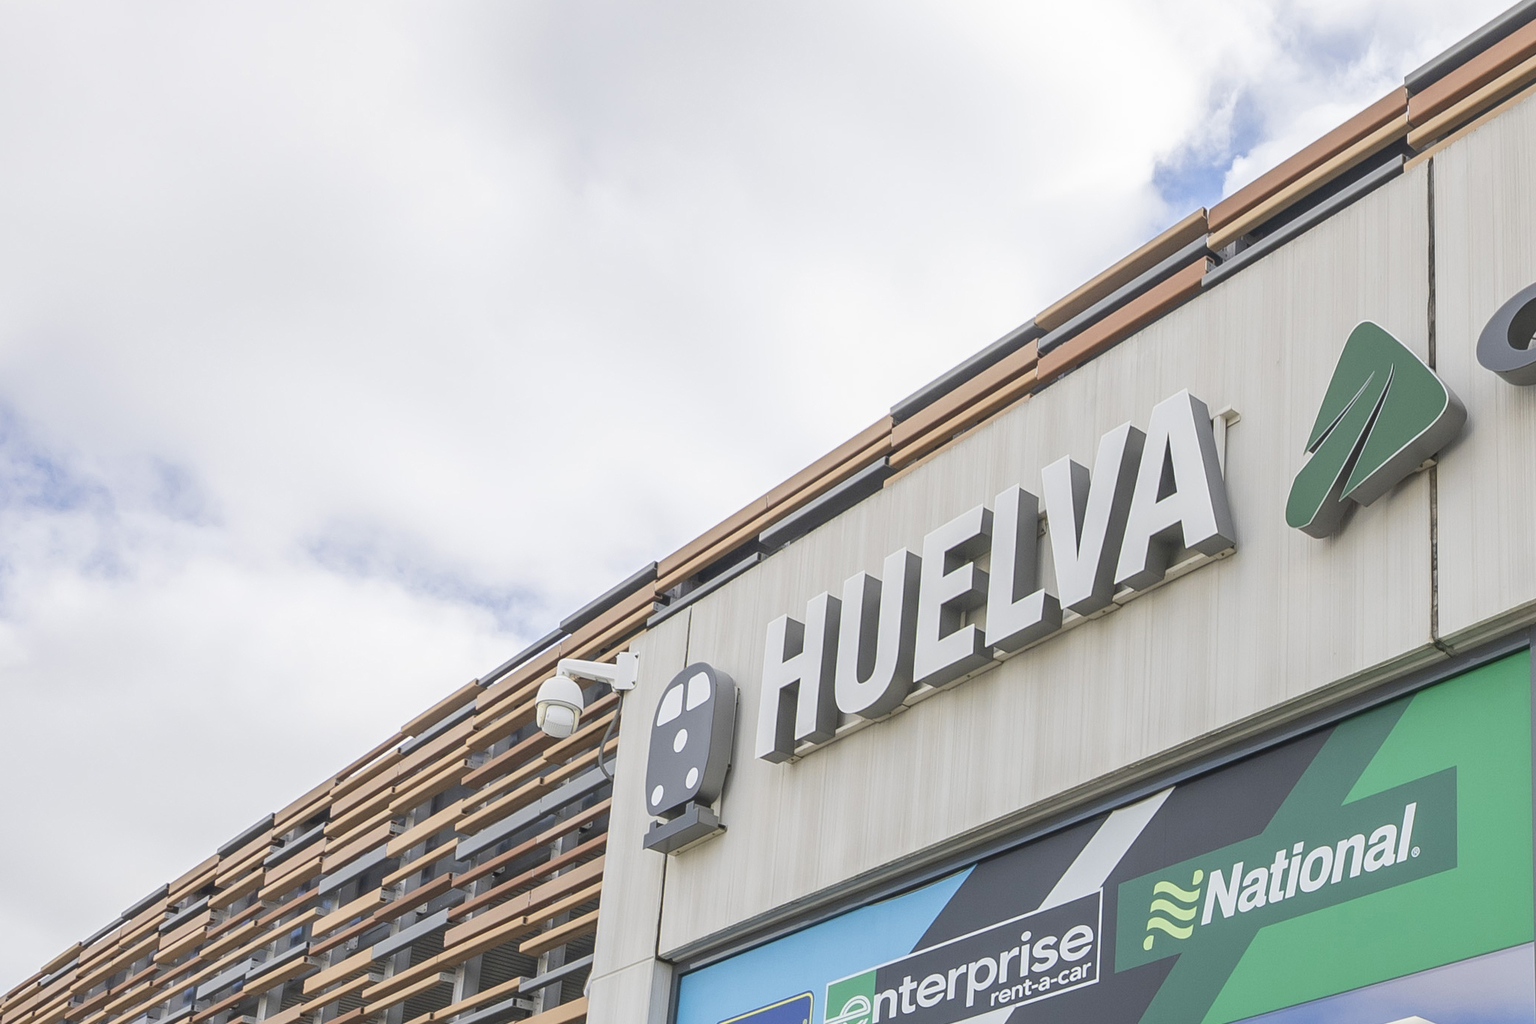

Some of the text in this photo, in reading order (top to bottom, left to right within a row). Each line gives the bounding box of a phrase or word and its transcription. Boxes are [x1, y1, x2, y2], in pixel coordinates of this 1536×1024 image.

[755, 388, 1236, 764] HUELVA
[1200, 802, 1418, 926] National
[990, 962, 1092, 1007] rent-a-car
